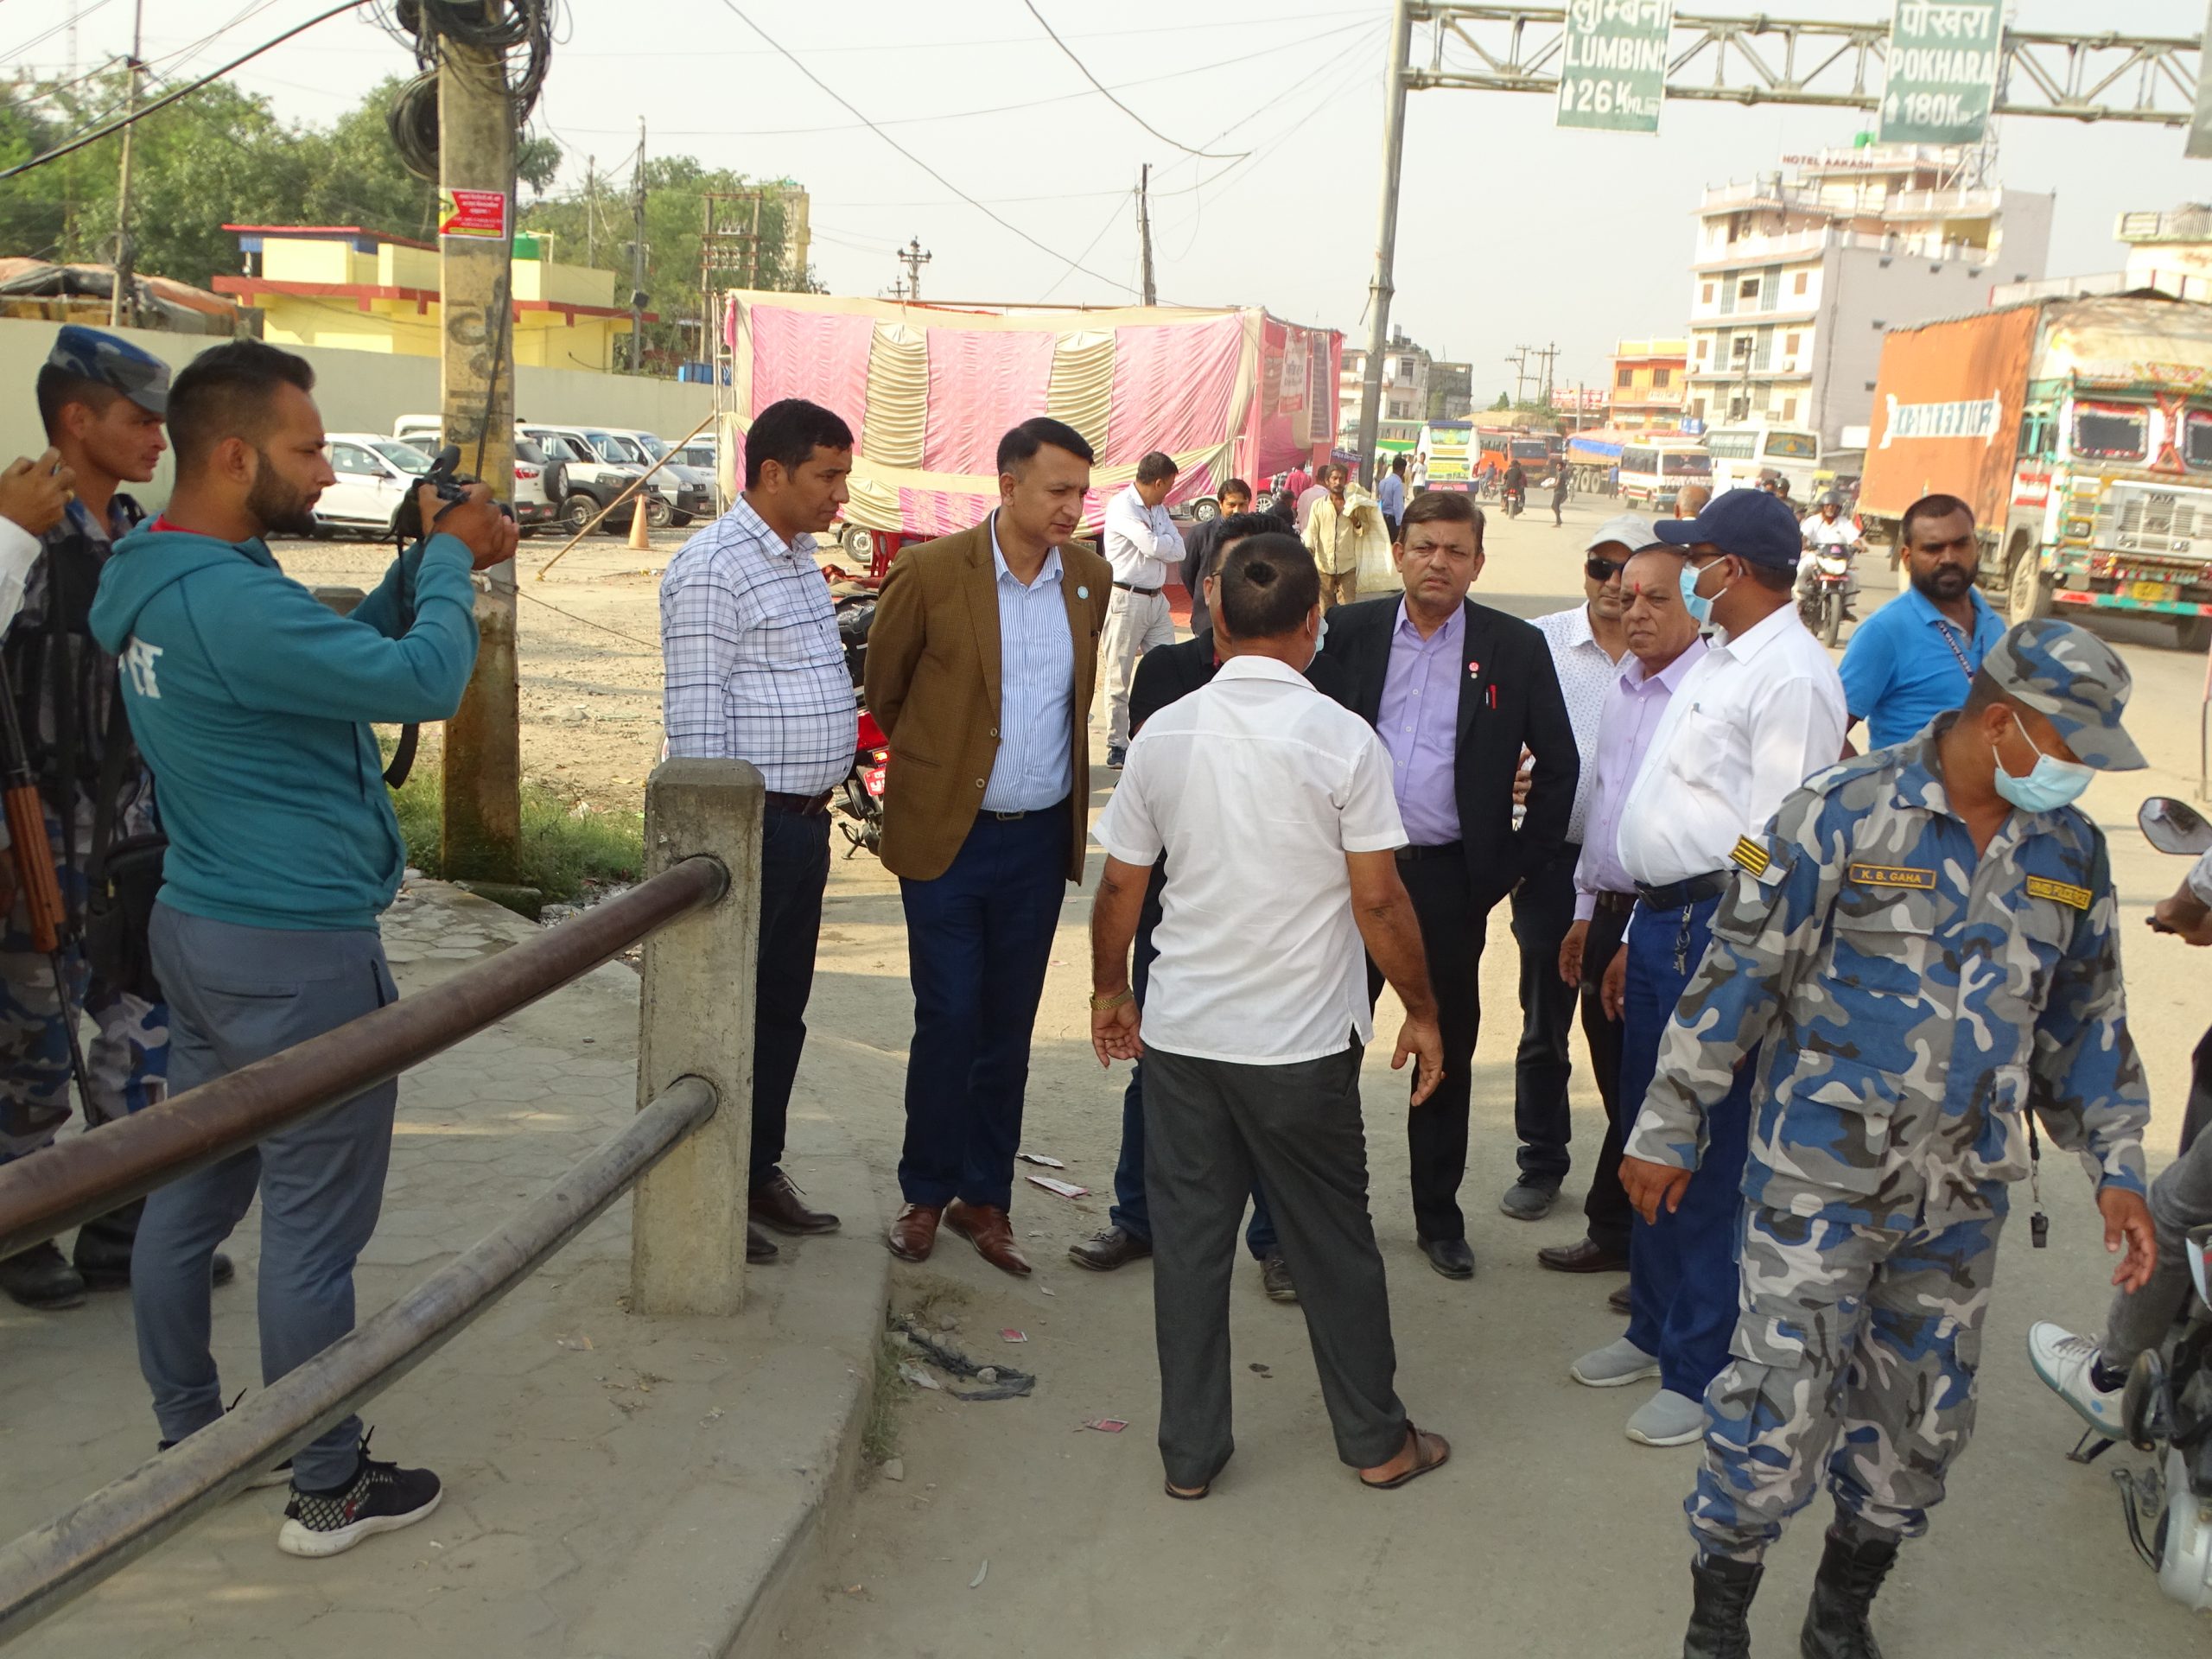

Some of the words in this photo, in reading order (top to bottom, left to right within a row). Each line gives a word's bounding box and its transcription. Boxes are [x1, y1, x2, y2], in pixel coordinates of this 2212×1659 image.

[1889, 47, 1993, 85] POKHARA
[1783, 155, 1820, 167] HOTEL
[1825, 157, 1872, 169] AAKASH
[2149, 493, 2175, 504] TATA
[1889, 872, 1922, 884] GAHA
